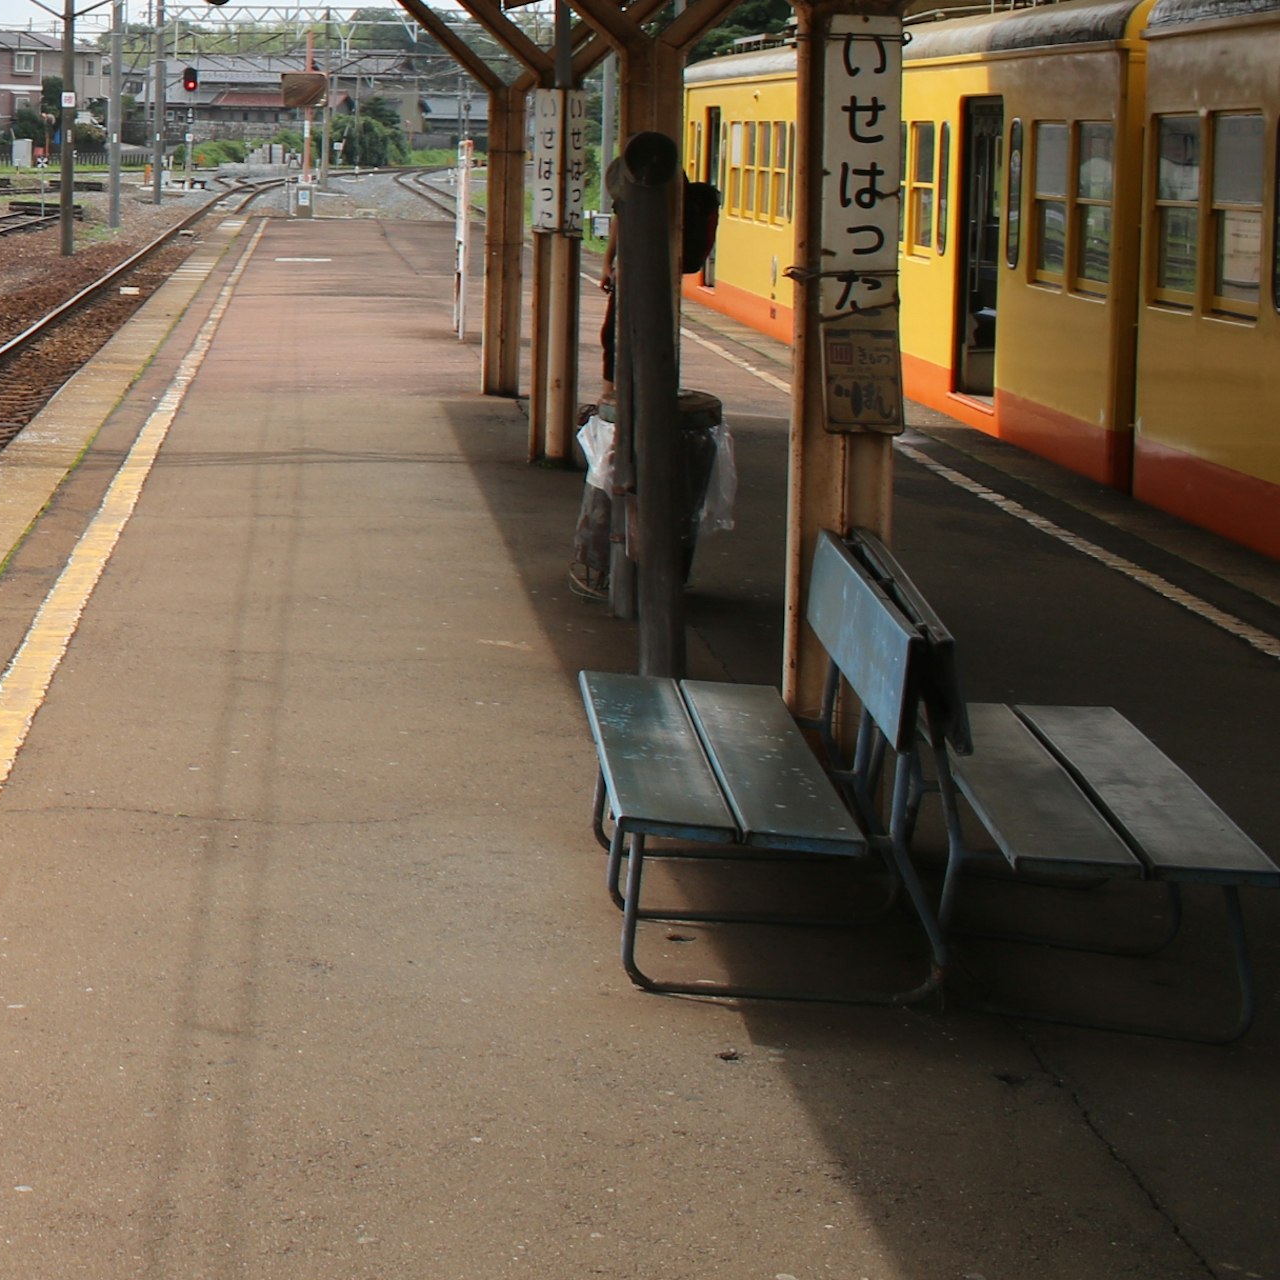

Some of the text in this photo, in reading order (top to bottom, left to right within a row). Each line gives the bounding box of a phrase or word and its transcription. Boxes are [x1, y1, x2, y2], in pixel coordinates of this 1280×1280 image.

[567, 98, 583, 231] いせはった
[834, 32, 886, 316] いせはった
